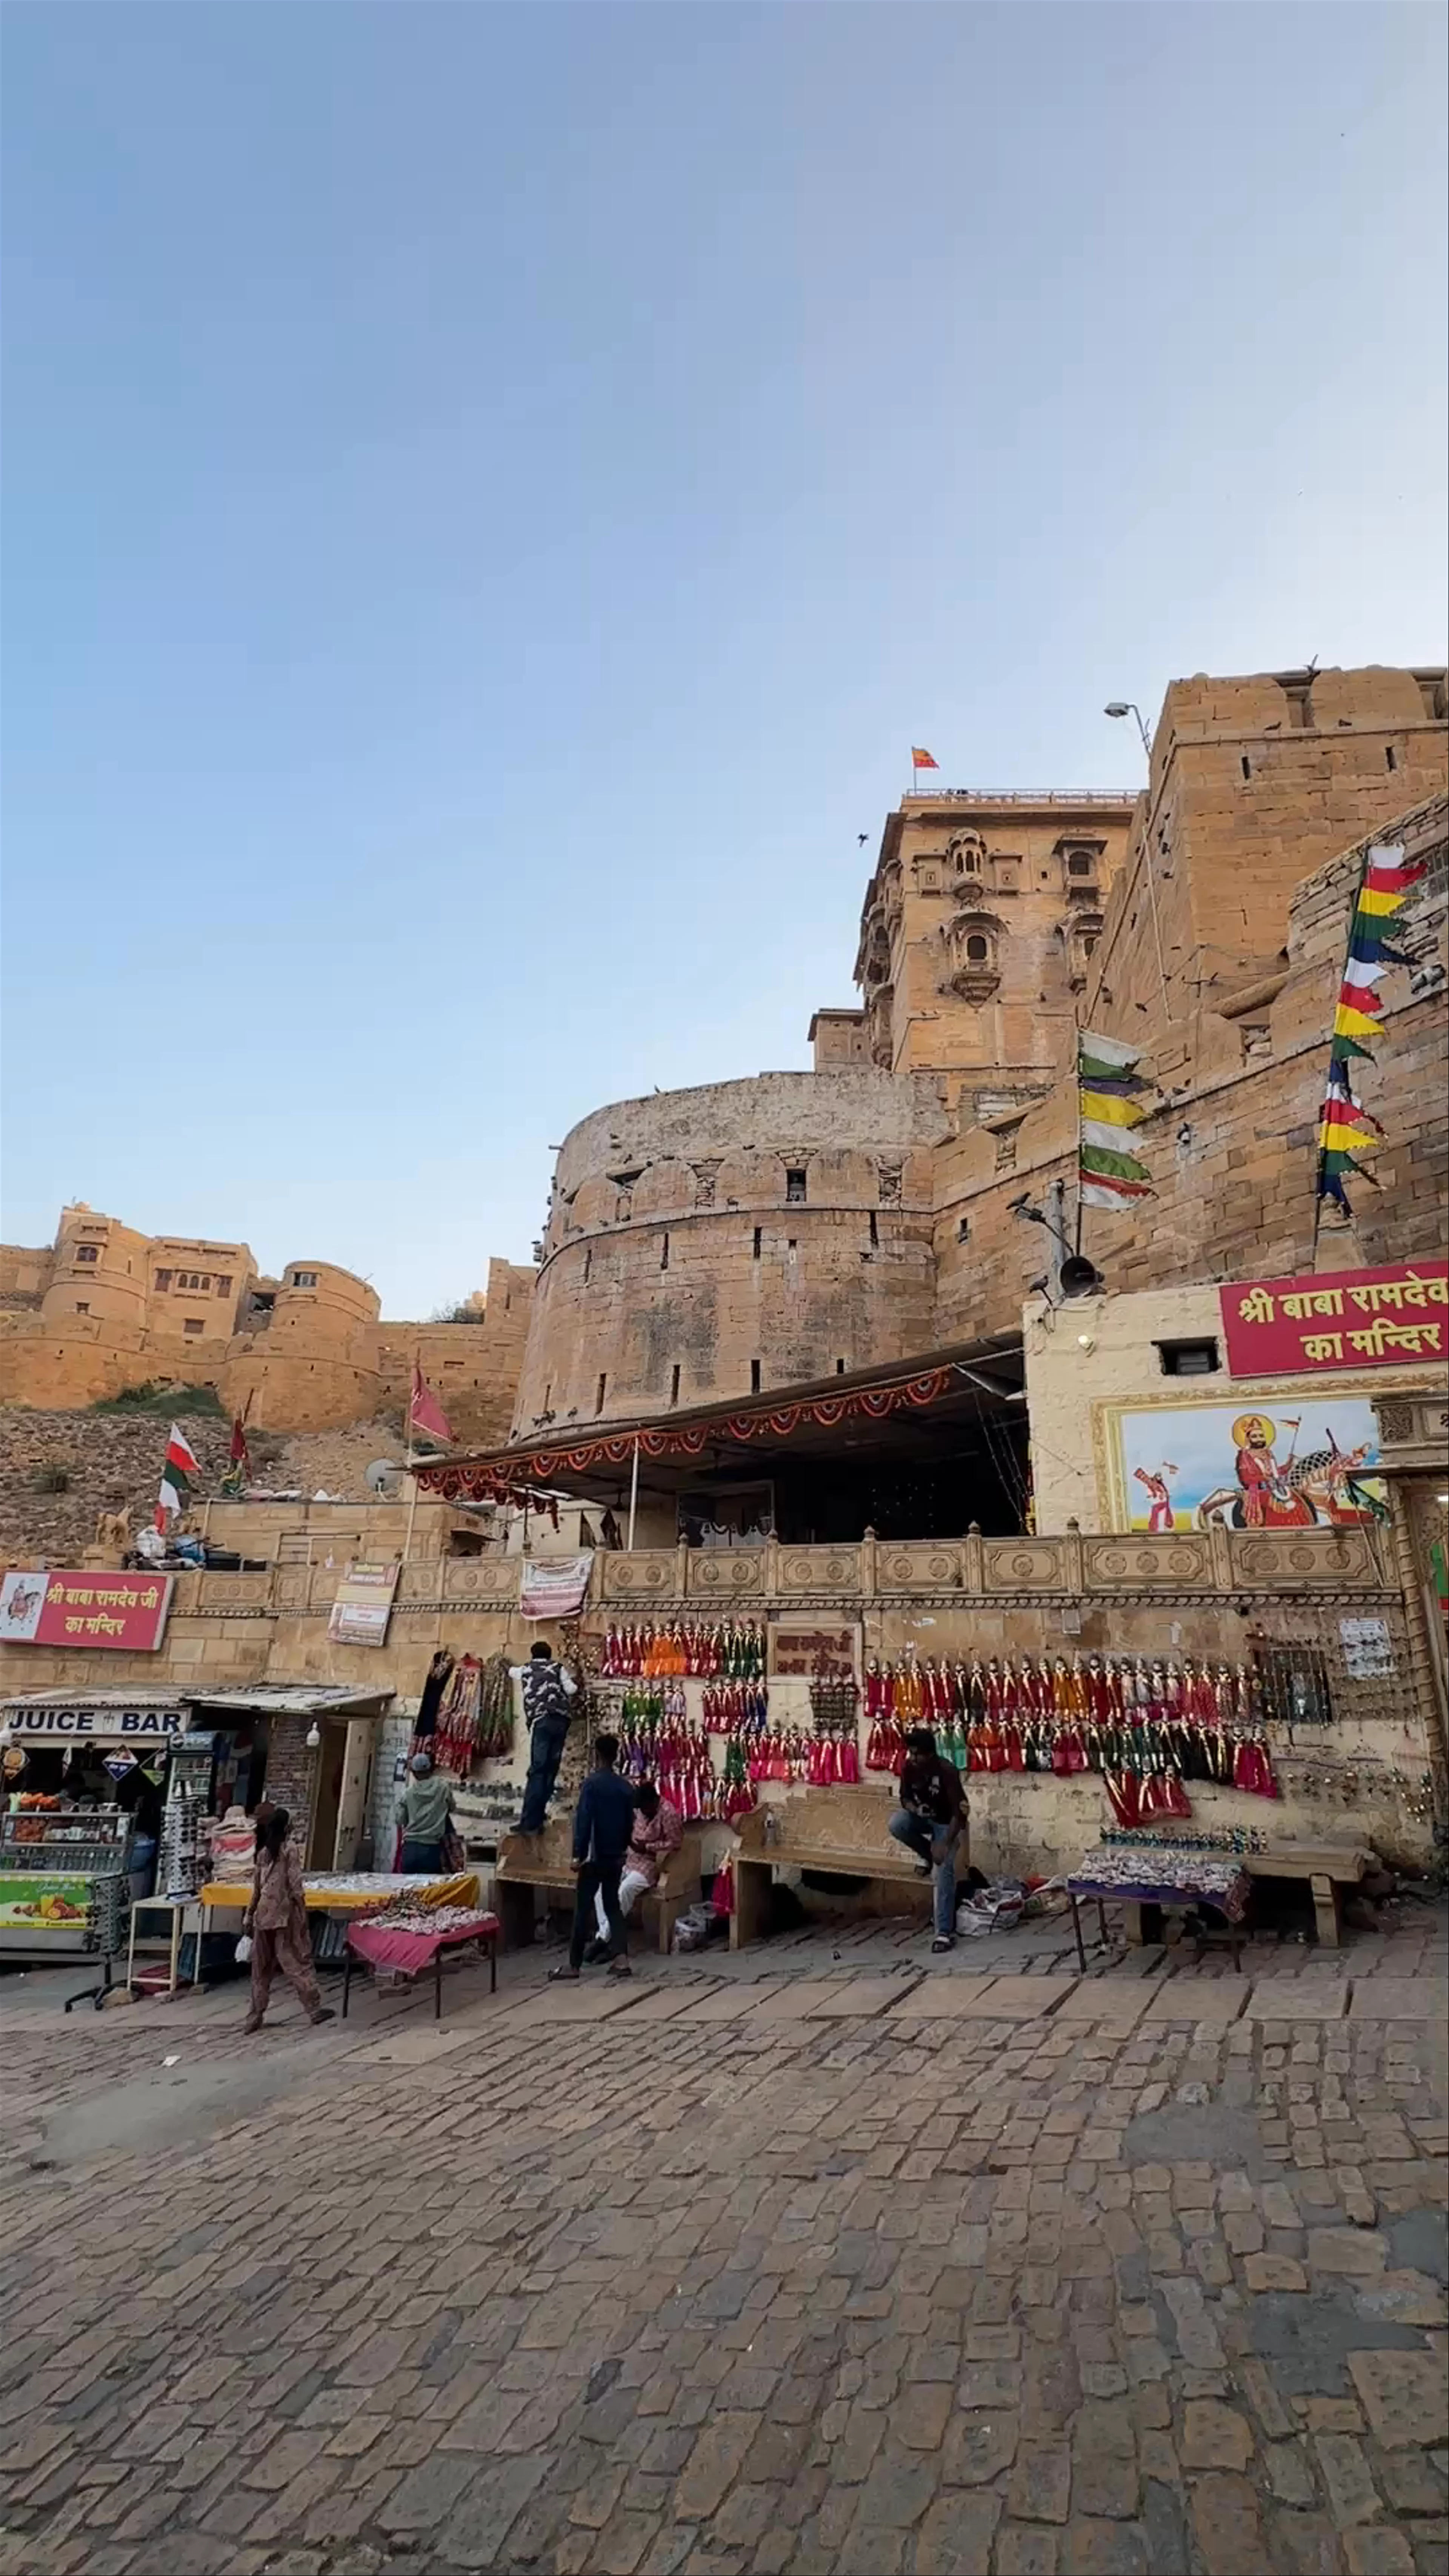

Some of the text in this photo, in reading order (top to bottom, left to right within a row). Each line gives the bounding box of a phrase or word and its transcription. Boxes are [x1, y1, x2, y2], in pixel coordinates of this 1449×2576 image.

[1238, 1269, 1449, 1323] श्री बाबा रामदेव
[1299, 1317, 1443, 1361] का मन्दिर
[47, 1583, 158, 1609] श्री बाबा रामदेव जी
[65, 1612, 126, 1636] का मन्दिर
[9, 1711, 181, 1732] JUICE BAR
